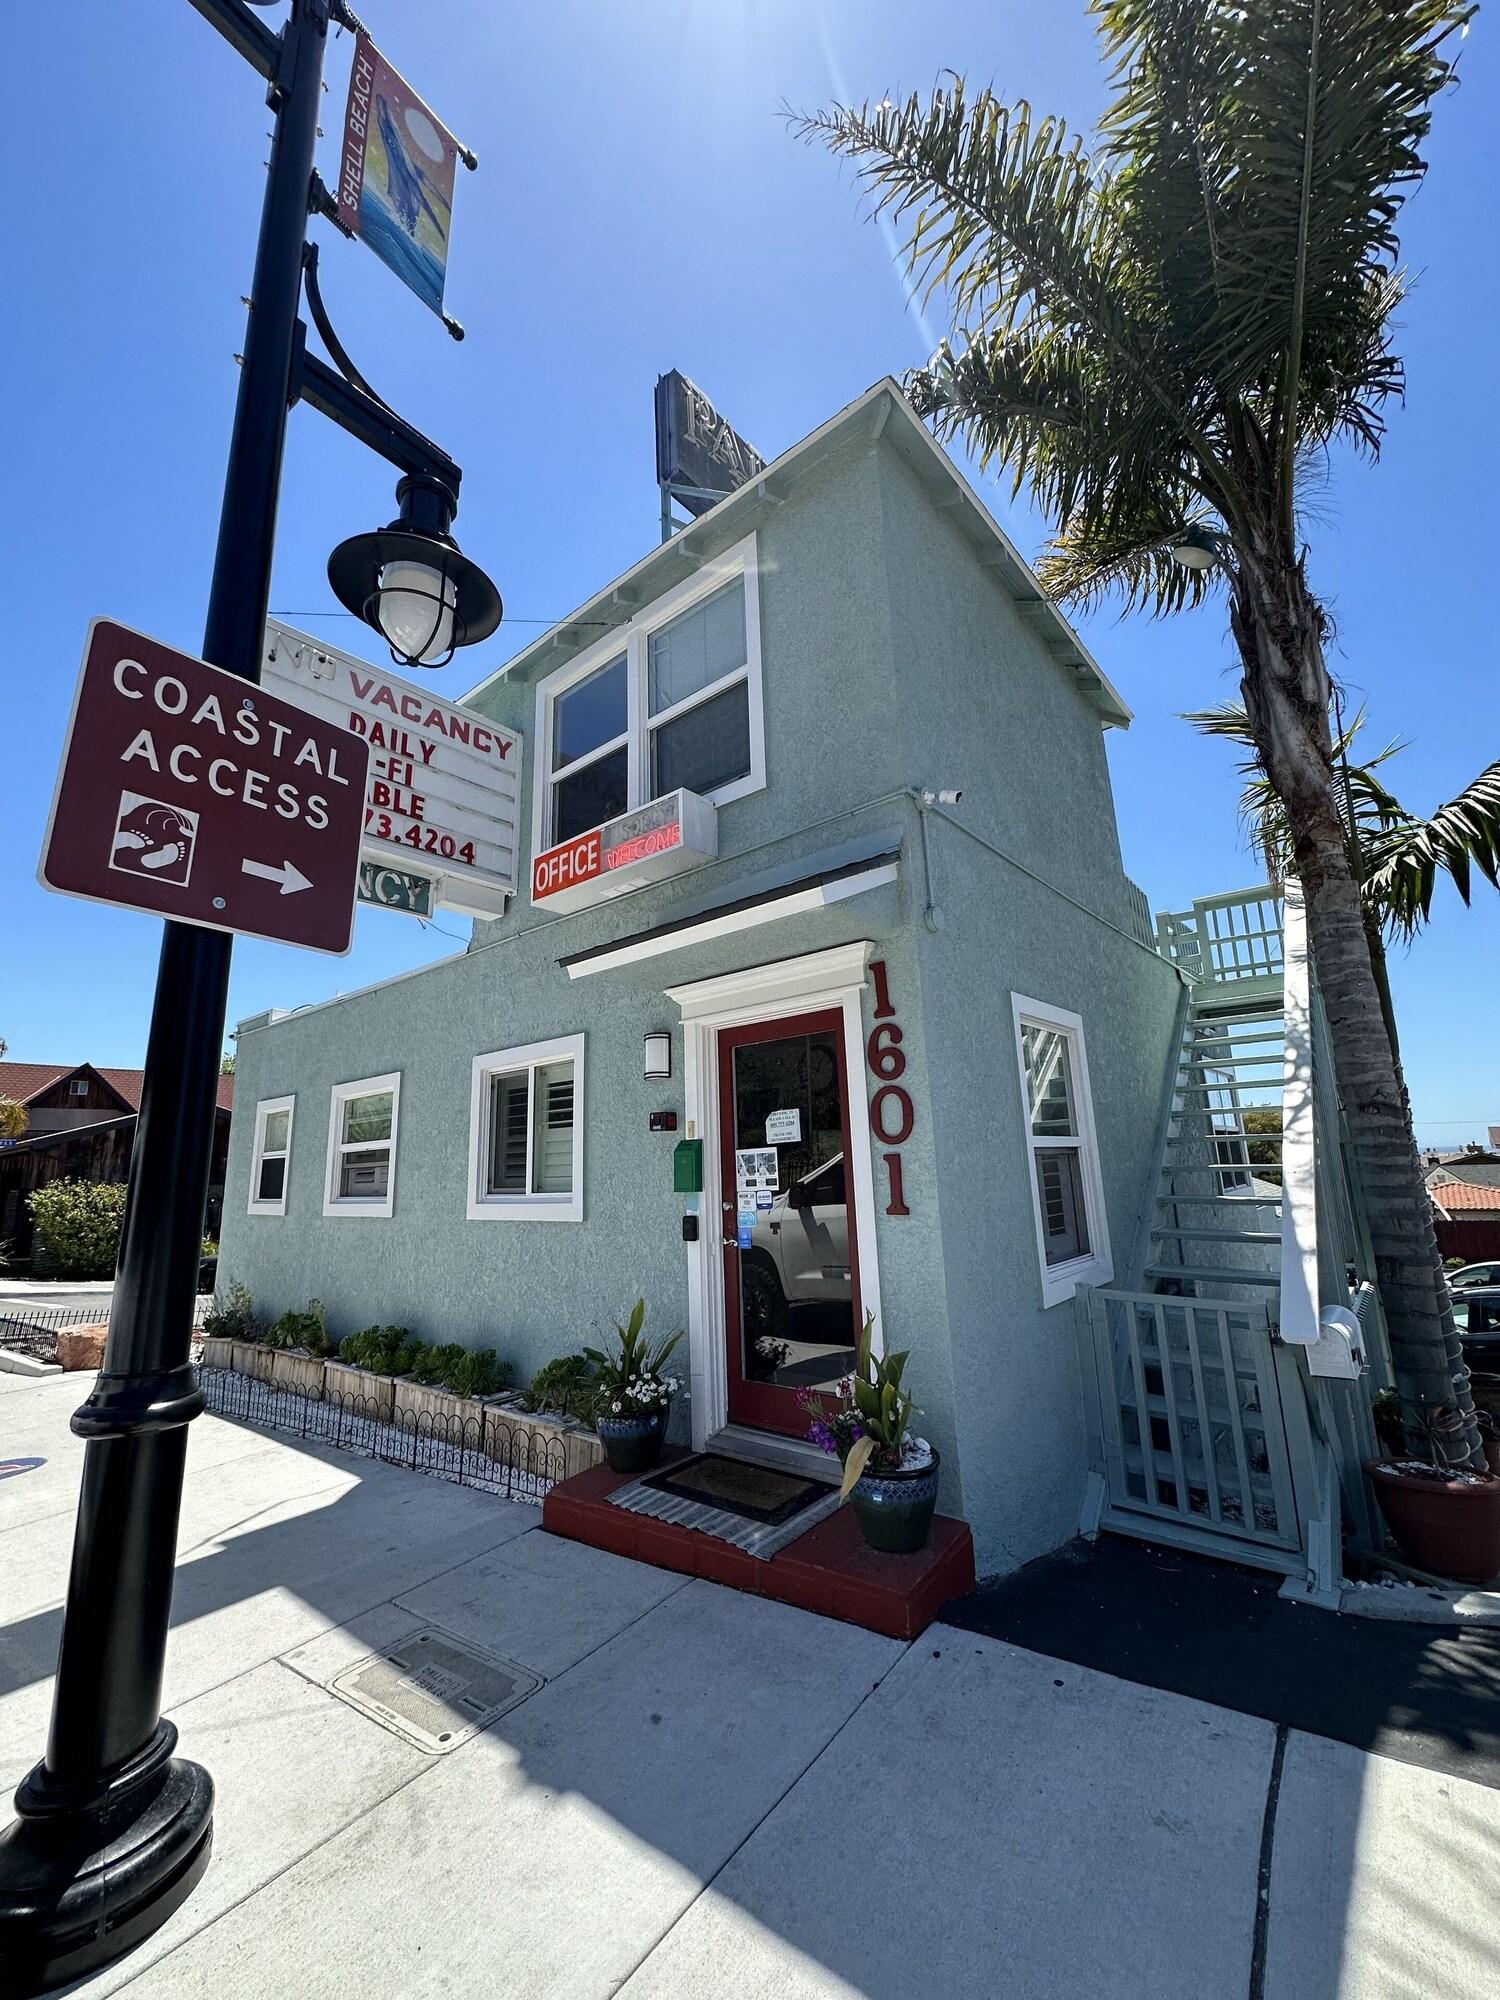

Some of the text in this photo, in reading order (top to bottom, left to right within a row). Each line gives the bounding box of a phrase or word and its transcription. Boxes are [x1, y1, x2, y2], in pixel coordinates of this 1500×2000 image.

[342, 55, 373, 212] SHELL BEACH
[112, 658, 350, 786] COASTAL
[349, 671, 513, 760] VACANCY
[350, 712, 436, 767] DAILY
[120, 728, 330, 831] ACCESS
[368, 780, 426, 821] BLE
[535, 838, 598, 892] OFFICE
[607, 824, 681, 869] WELCOME
[868, 960, 914, 1216] 1601
